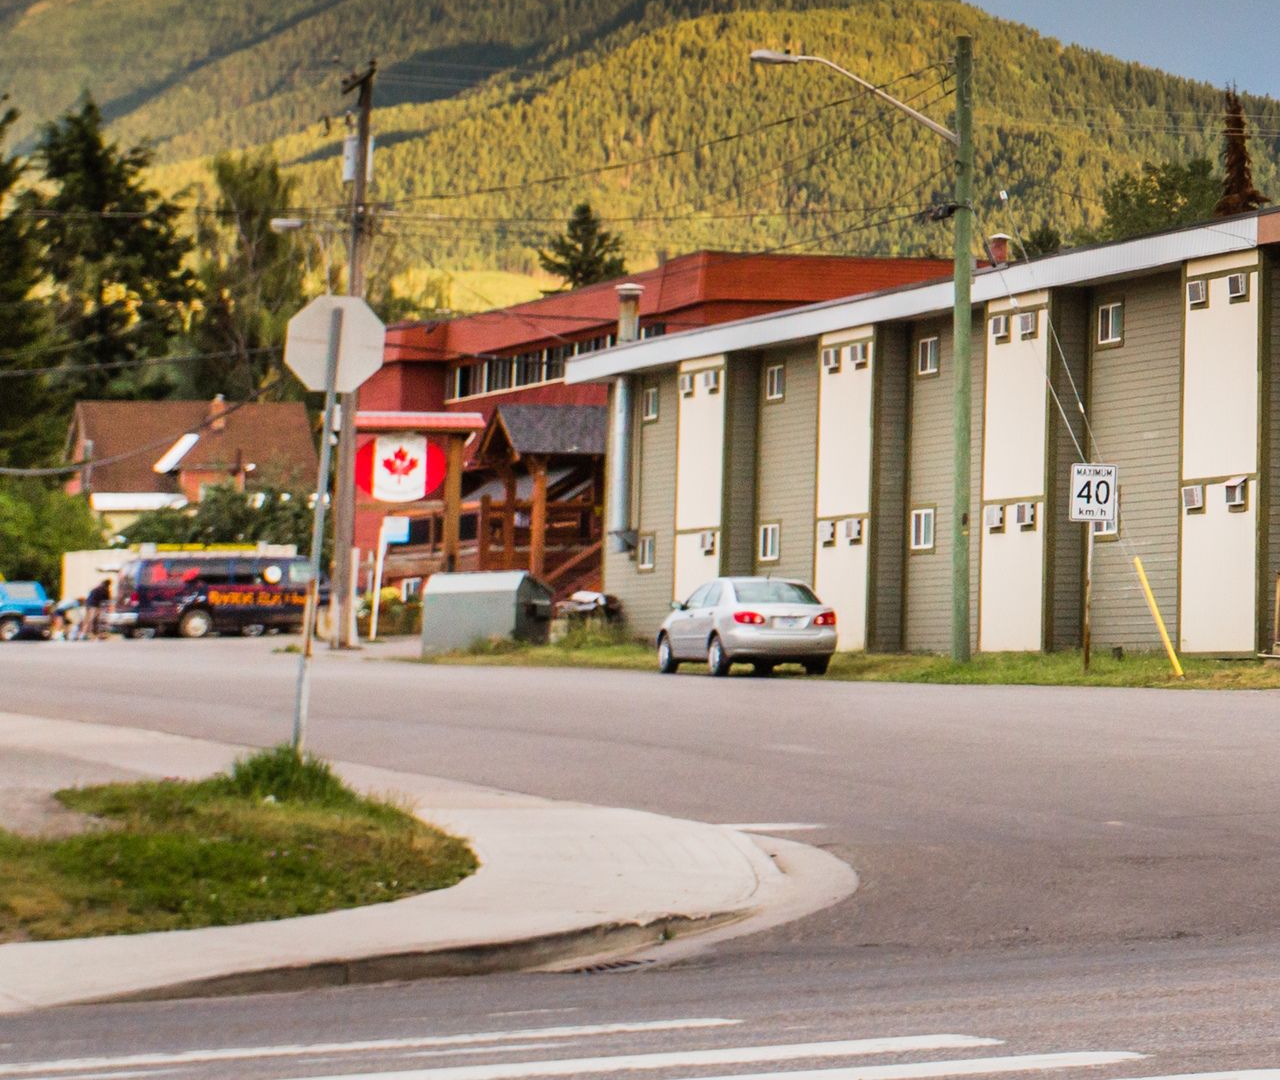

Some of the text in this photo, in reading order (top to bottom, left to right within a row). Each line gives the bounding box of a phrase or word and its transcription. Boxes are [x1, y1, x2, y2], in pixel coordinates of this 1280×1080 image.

[1076, 468, 1113, 476] MAXIMUM
[1076, 480, 1111, 505] 40
[1078, 507, 1107, 517] km/h
